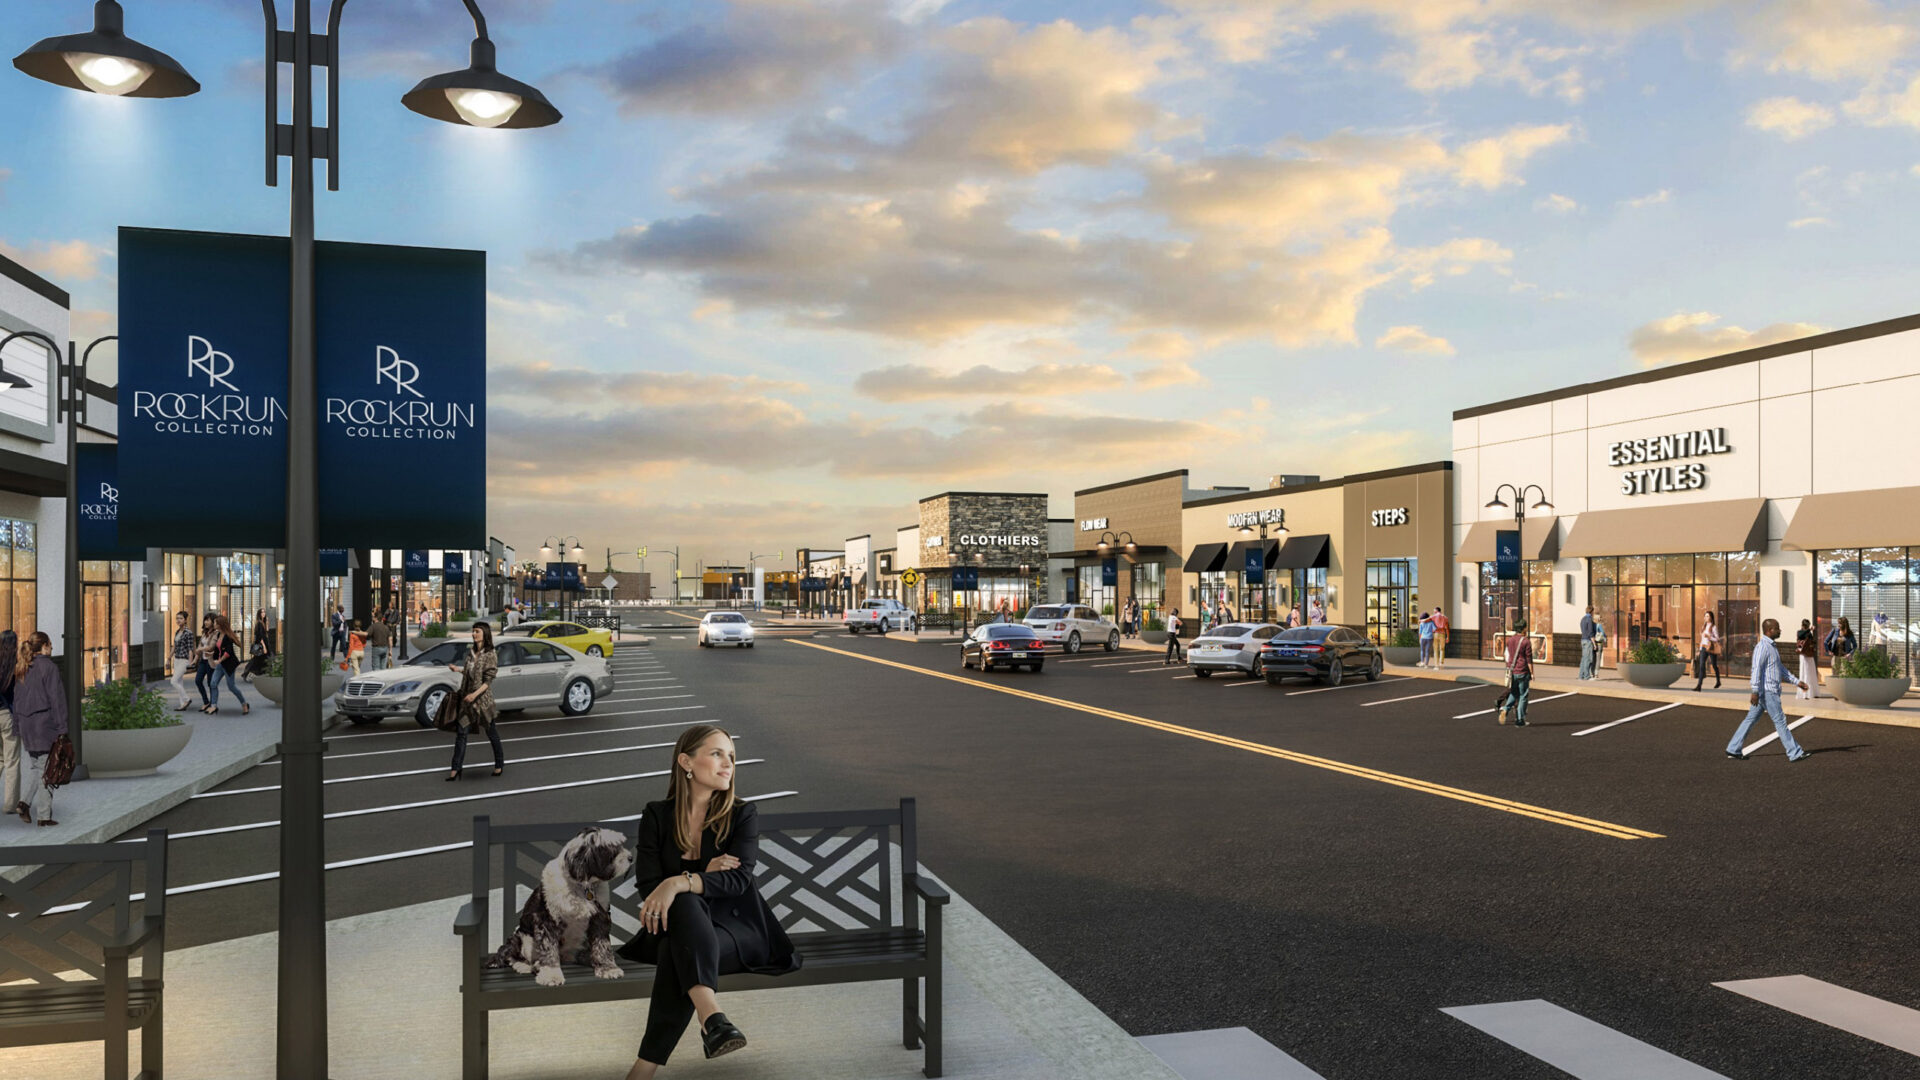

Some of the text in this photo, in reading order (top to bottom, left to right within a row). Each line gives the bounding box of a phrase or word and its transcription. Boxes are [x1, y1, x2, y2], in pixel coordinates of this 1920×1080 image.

[134, 391, 288, 422] ROCKRUN
[327, 398, 474, 428] ROCKRUN
[155, 421, 273, 436] COLLECTION
[346, 426, 456, 440] COLLECTION
[1608, 427, 1731, 466] ESSENTIAL
[1621, 463, 1706, 496] STYLES
[81, 503, 118, 515] ROCK
[1260, 508, 1285, 524] WEAR
[1371, 507, 1408, 527] STEPS
[960, 535, 1039, 546] CLOTHIERS
